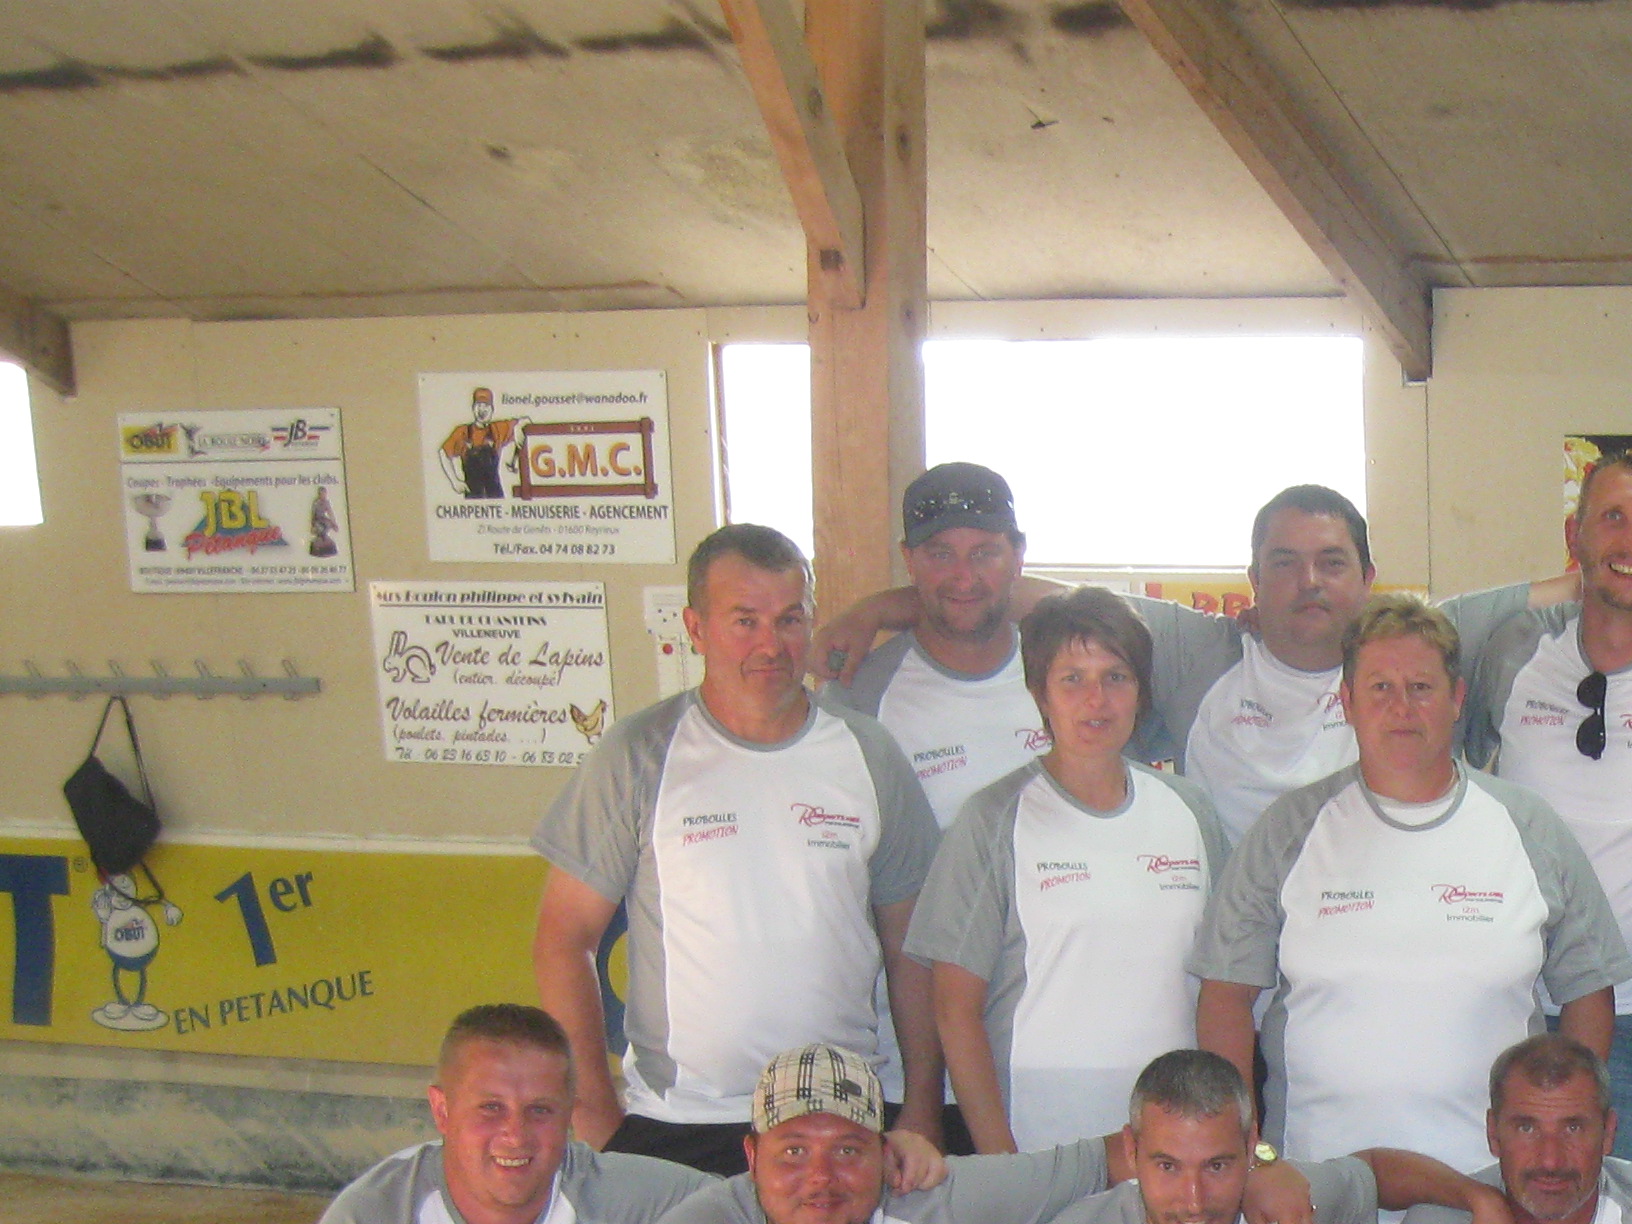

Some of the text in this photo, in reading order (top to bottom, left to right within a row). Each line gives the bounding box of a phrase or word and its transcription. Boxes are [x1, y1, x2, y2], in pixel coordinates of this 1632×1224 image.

[531, 442, 642, 478] G.M.C.
[201, 490, 269, 537] JBL
[436, 504, 668, 519] CHARPENTE MENUISERIE AGENCEMENT
[555, 544, 568, 555] 74
[452, 629, 521, 639] VILLENEUVE
[435, 640, 604, 673] Vente de Lapins
[386, 696, 567, 729] Volailles fermières
[682, 812, 738, 827] PROBOULES
[682, 824, 739, 847] PROMOTION
[1040, 871, 1092, 892] PROMOTION
[1320, 890, 1375, 901] PROBOULES
[1317, 901, 1376, 919] PROMOTION
[174, 970, 376, 1035] EN PETANQUE
